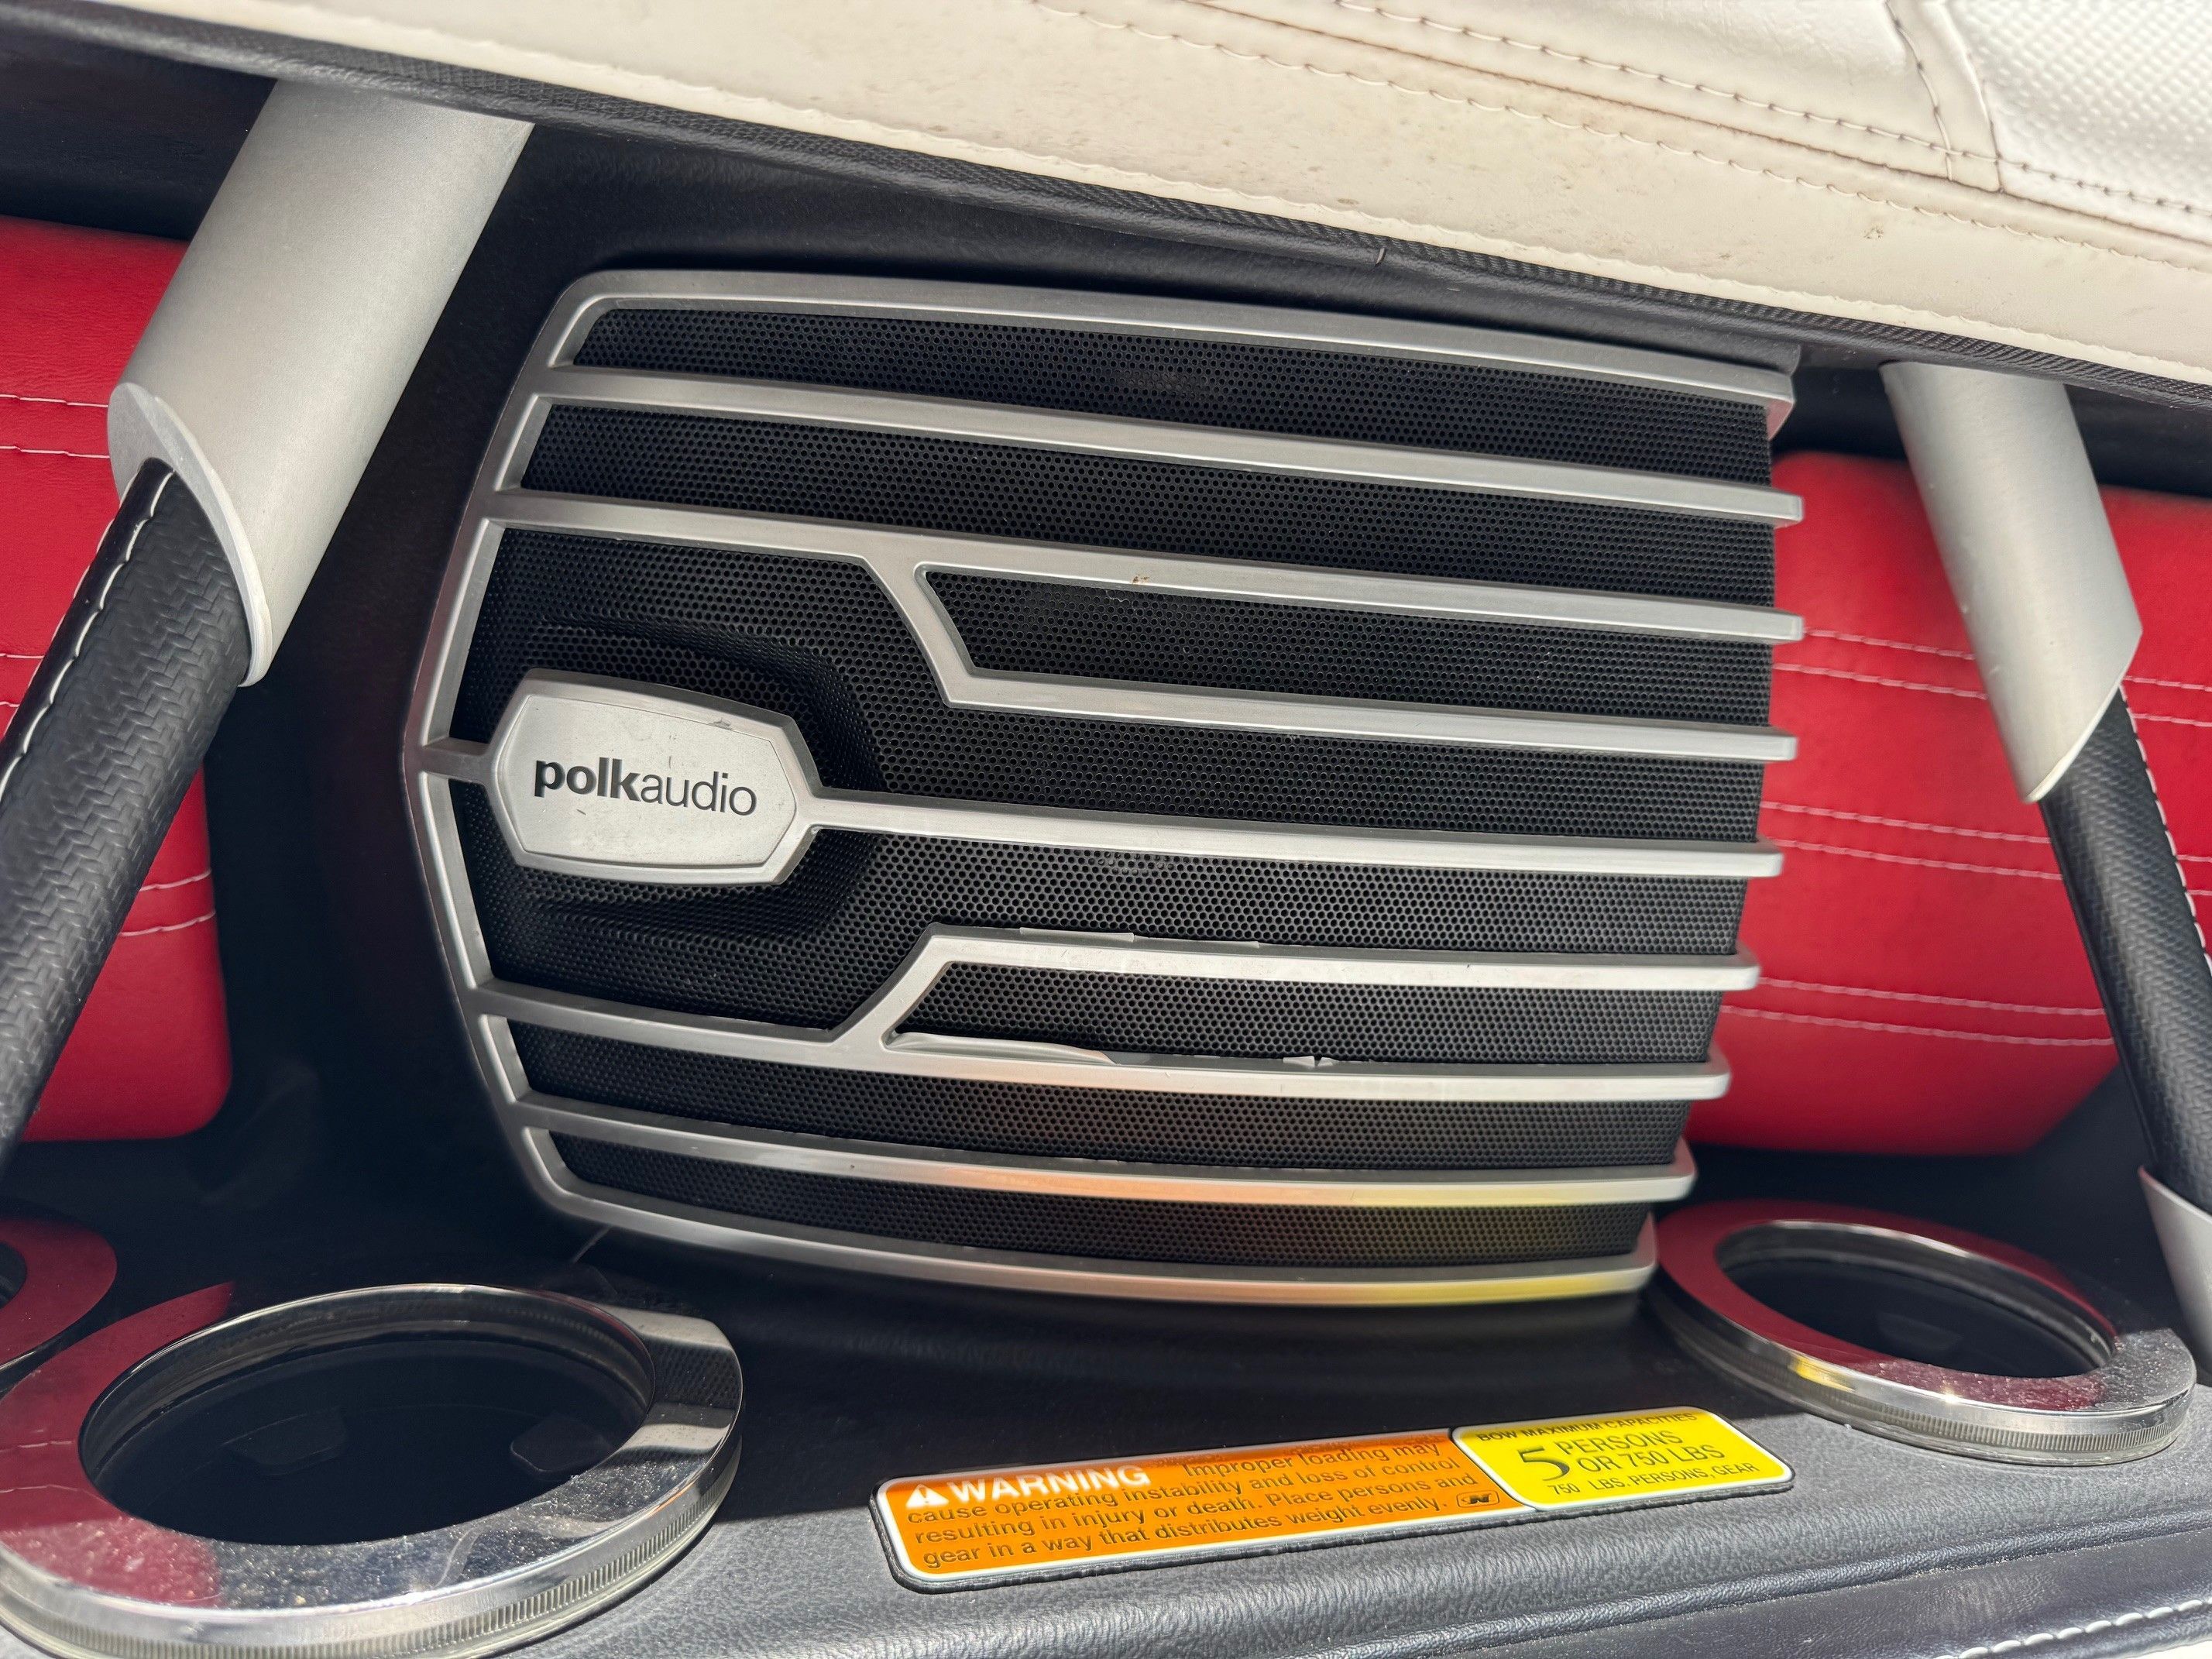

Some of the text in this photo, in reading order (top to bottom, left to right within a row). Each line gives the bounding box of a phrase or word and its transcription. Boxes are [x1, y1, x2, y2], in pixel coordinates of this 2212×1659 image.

[534, 757, 757, 816] polkaudio
[1477, 1413, 1697, 1441] BOW MAXIMUM CAPACITIES
[949, 1444, 1440, 1502] WARNING Improper loading may
[1517, 1431, 1684, 1482] 5 PERSONS
[1548, 1483, 1581, 1495] 750
[1630, 1468, 1716, 1486] PERSONS,
[1712, 1463, 1760, 1475] GEAR
[1577, 1445, 1725, 1472] OR 750 LBS
[908, 1458, 1461, 1523] cause operating instability and loss of control
[915, 1475, 1479, 1544] resulting in injury or death. Place persons and
[924, 1548, 979, 1568] gear
[988, 1543, 1015, 1558] in
[1023, 1542, 1038, 1554] a
[1042, 1534, 1092, 1551] way
[1099, 1528, 1150, 1544] that
[1155, 1516, 1283, 1539] distributes
[1286, 1506, 1365, 1523] weight
[1370, 1498, 1448, 1515] evenly.
